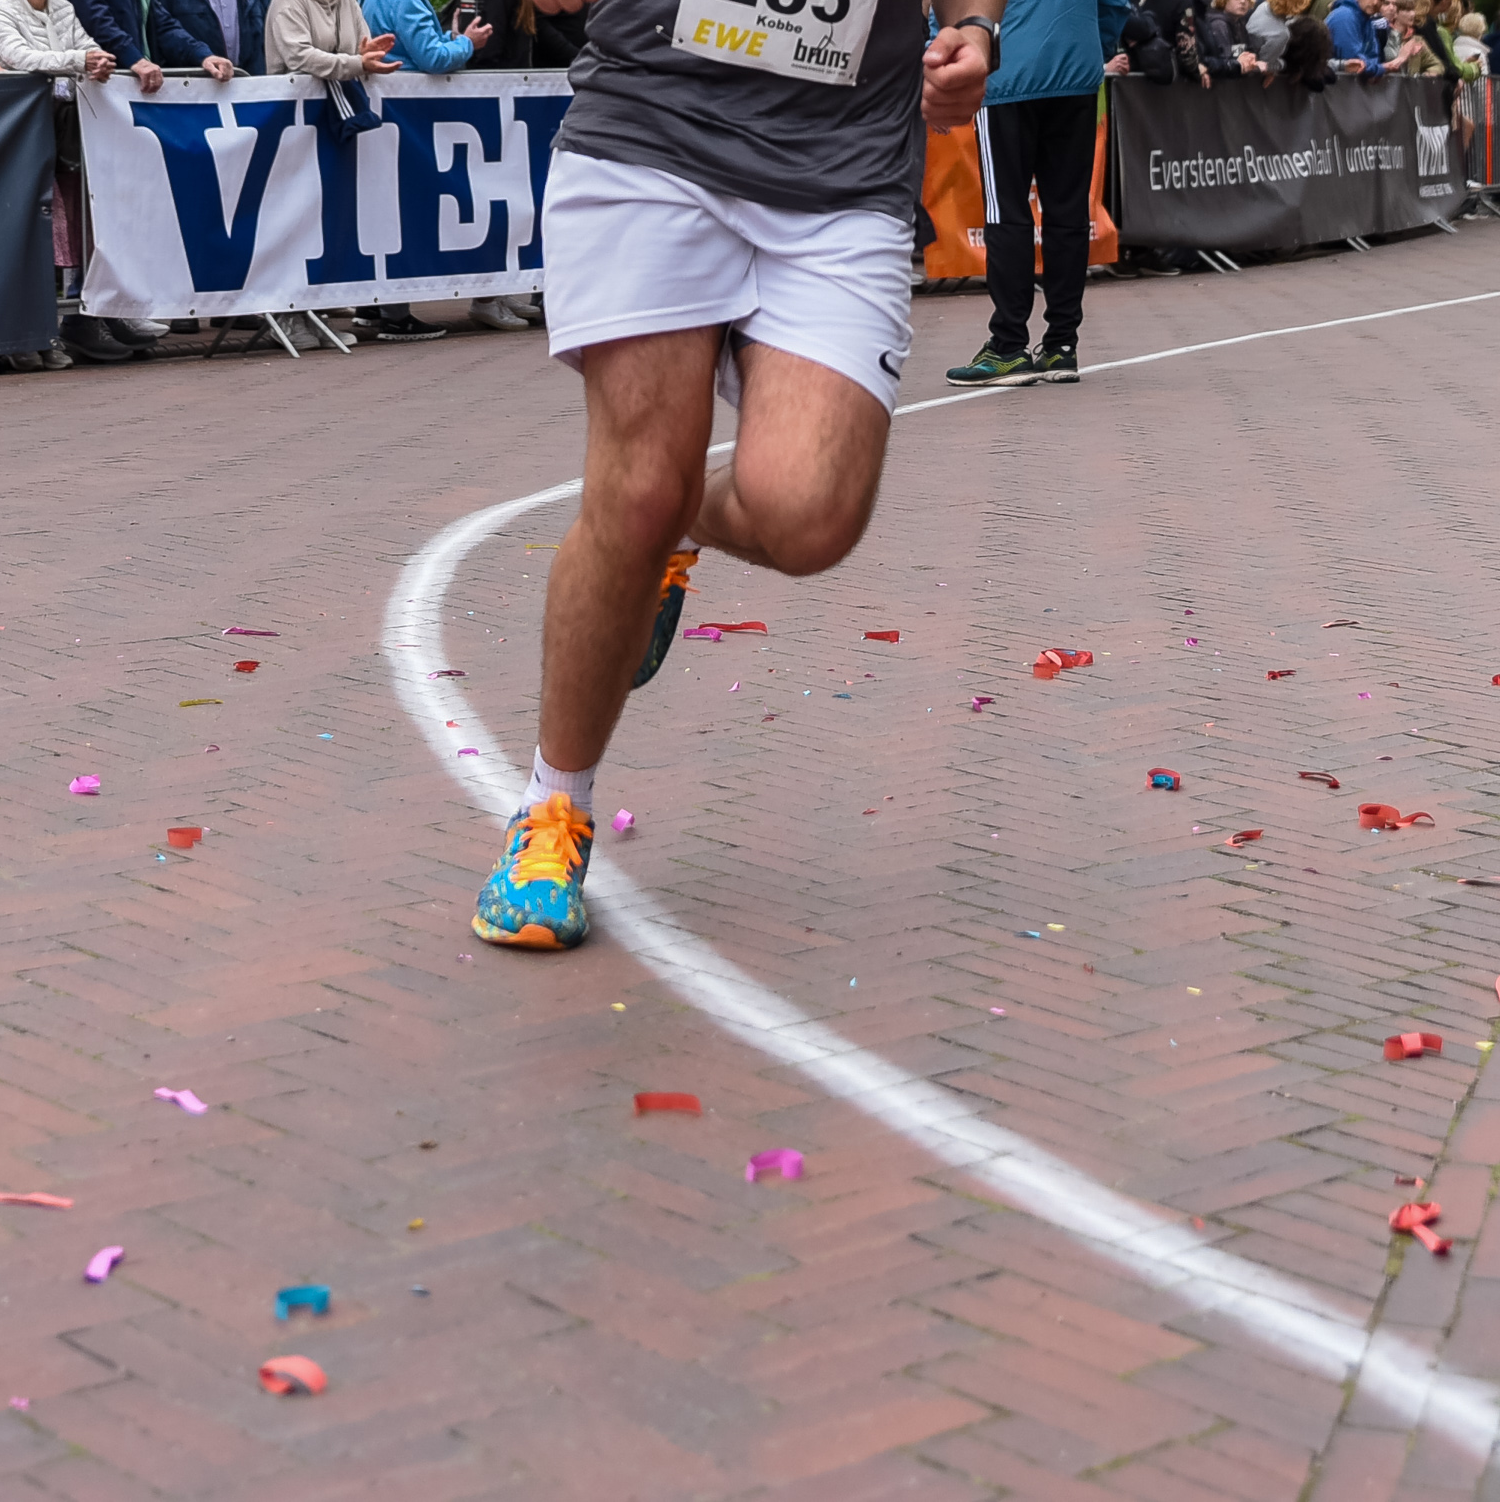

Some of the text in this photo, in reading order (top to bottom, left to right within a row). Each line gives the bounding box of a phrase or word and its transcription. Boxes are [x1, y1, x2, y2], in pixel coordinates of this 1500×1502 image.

[692, 19, 769, 57] EWE
[756, 15, 803, 35] Kobbe
[793, 38, 851, 70] bruns
[1150, 150, 1243, 190] Everstener
